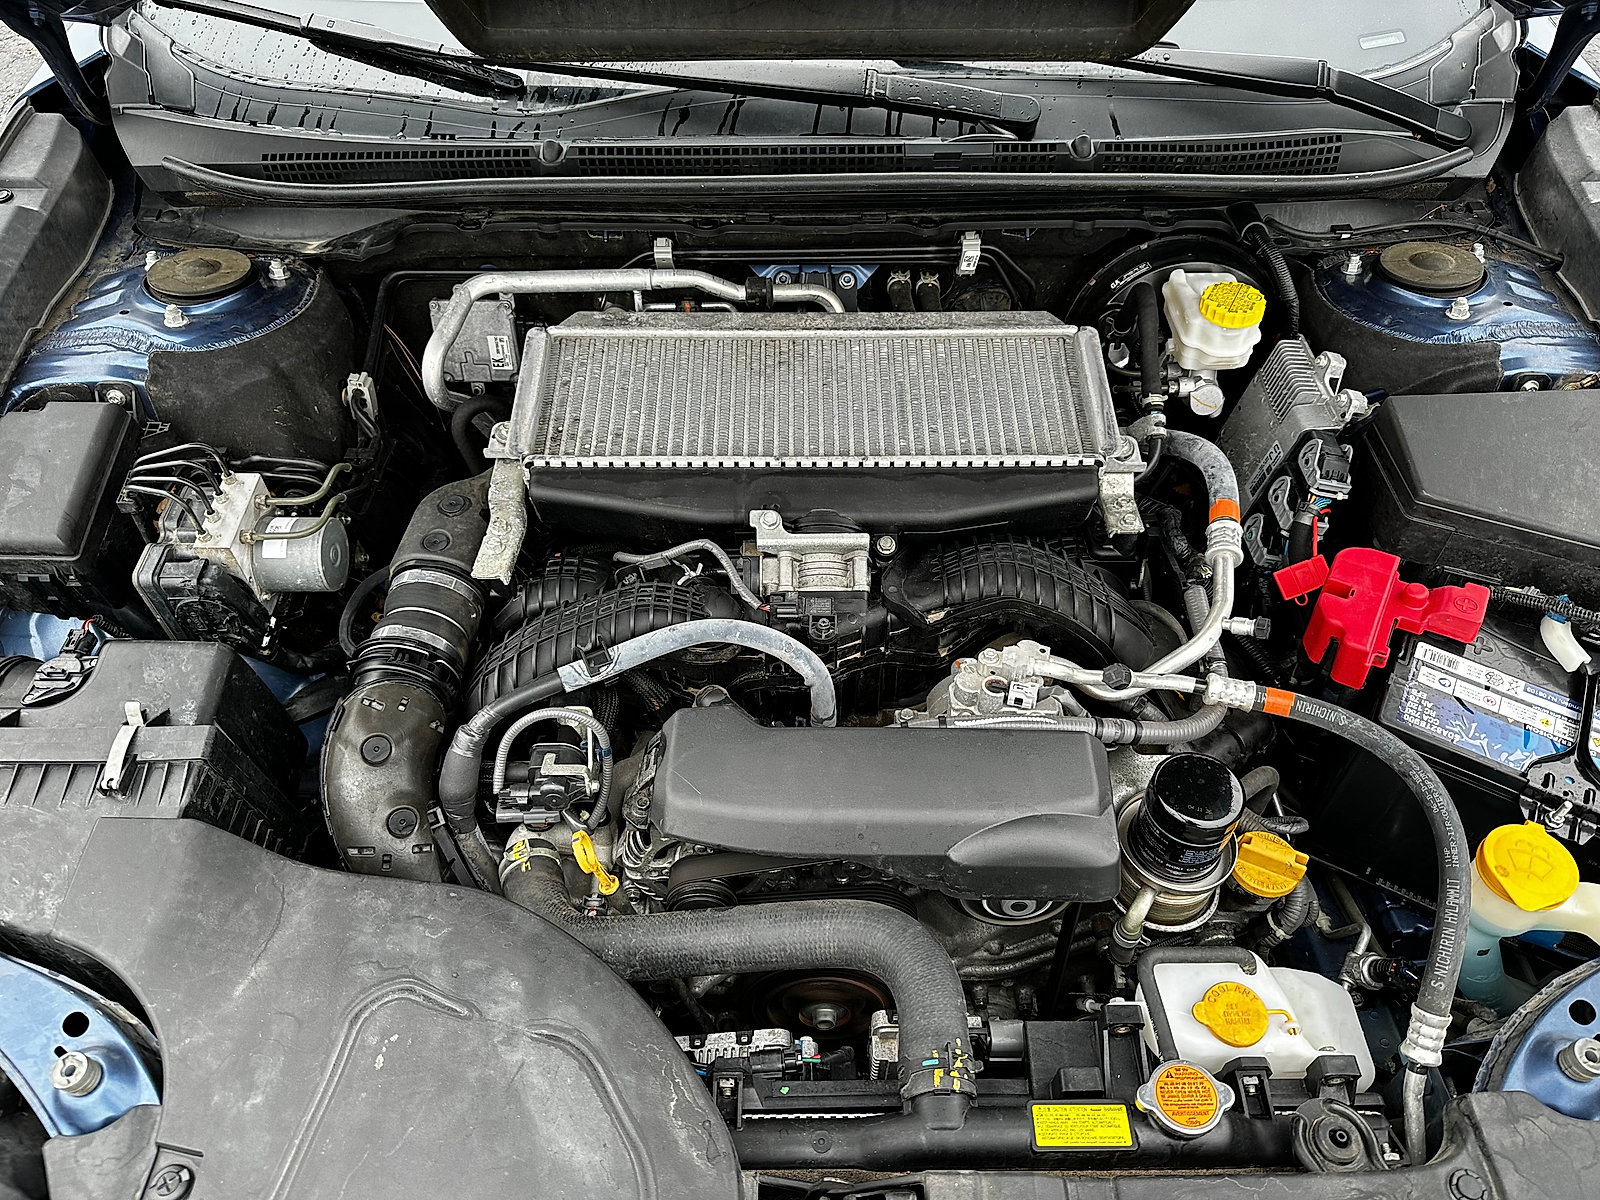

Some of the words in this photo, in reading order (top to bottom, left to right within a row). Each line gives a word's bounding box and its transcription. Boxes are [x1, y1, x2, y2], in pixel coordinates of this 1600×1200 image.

[492, 358, 504, 367] EK
[1407, 701, 1424, 712] 120
[1424, 707, 1437, 717] RC
[1422, 713, 1440, 726] CCA
[1207, 984, 1258, 1003] COOLANT
